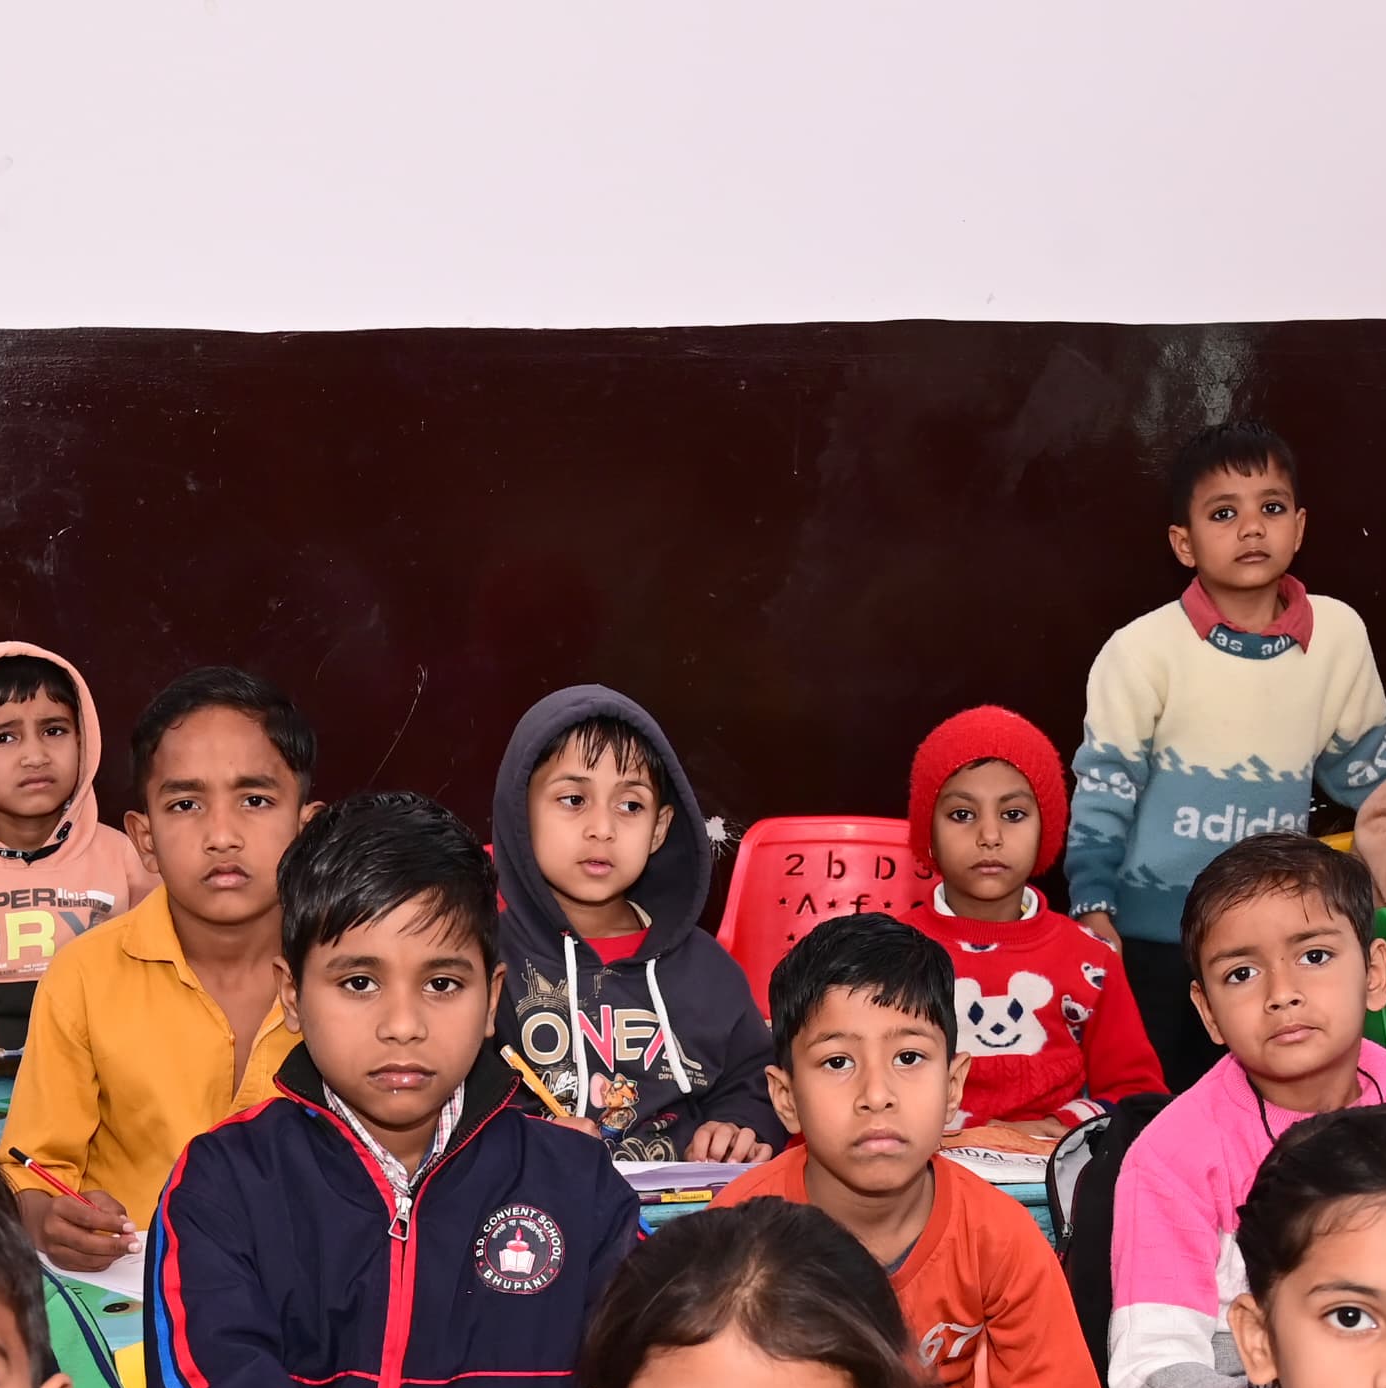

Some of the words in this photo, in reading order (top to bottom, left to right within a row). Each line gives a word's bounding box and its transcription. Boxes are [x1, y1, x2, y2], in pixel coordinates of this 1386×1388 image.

[785, 854, 804, 876] 2
[827, 851, 846, 879] b
[875, 856, 896, 880] D
[483, 1207, 537, 1232] CONVENT
[538, 1215, 562, 1261] SCHOOL
[484, 1269, 547, 1290] BHUPANI
[918, 1322, 984, 1368] 67
